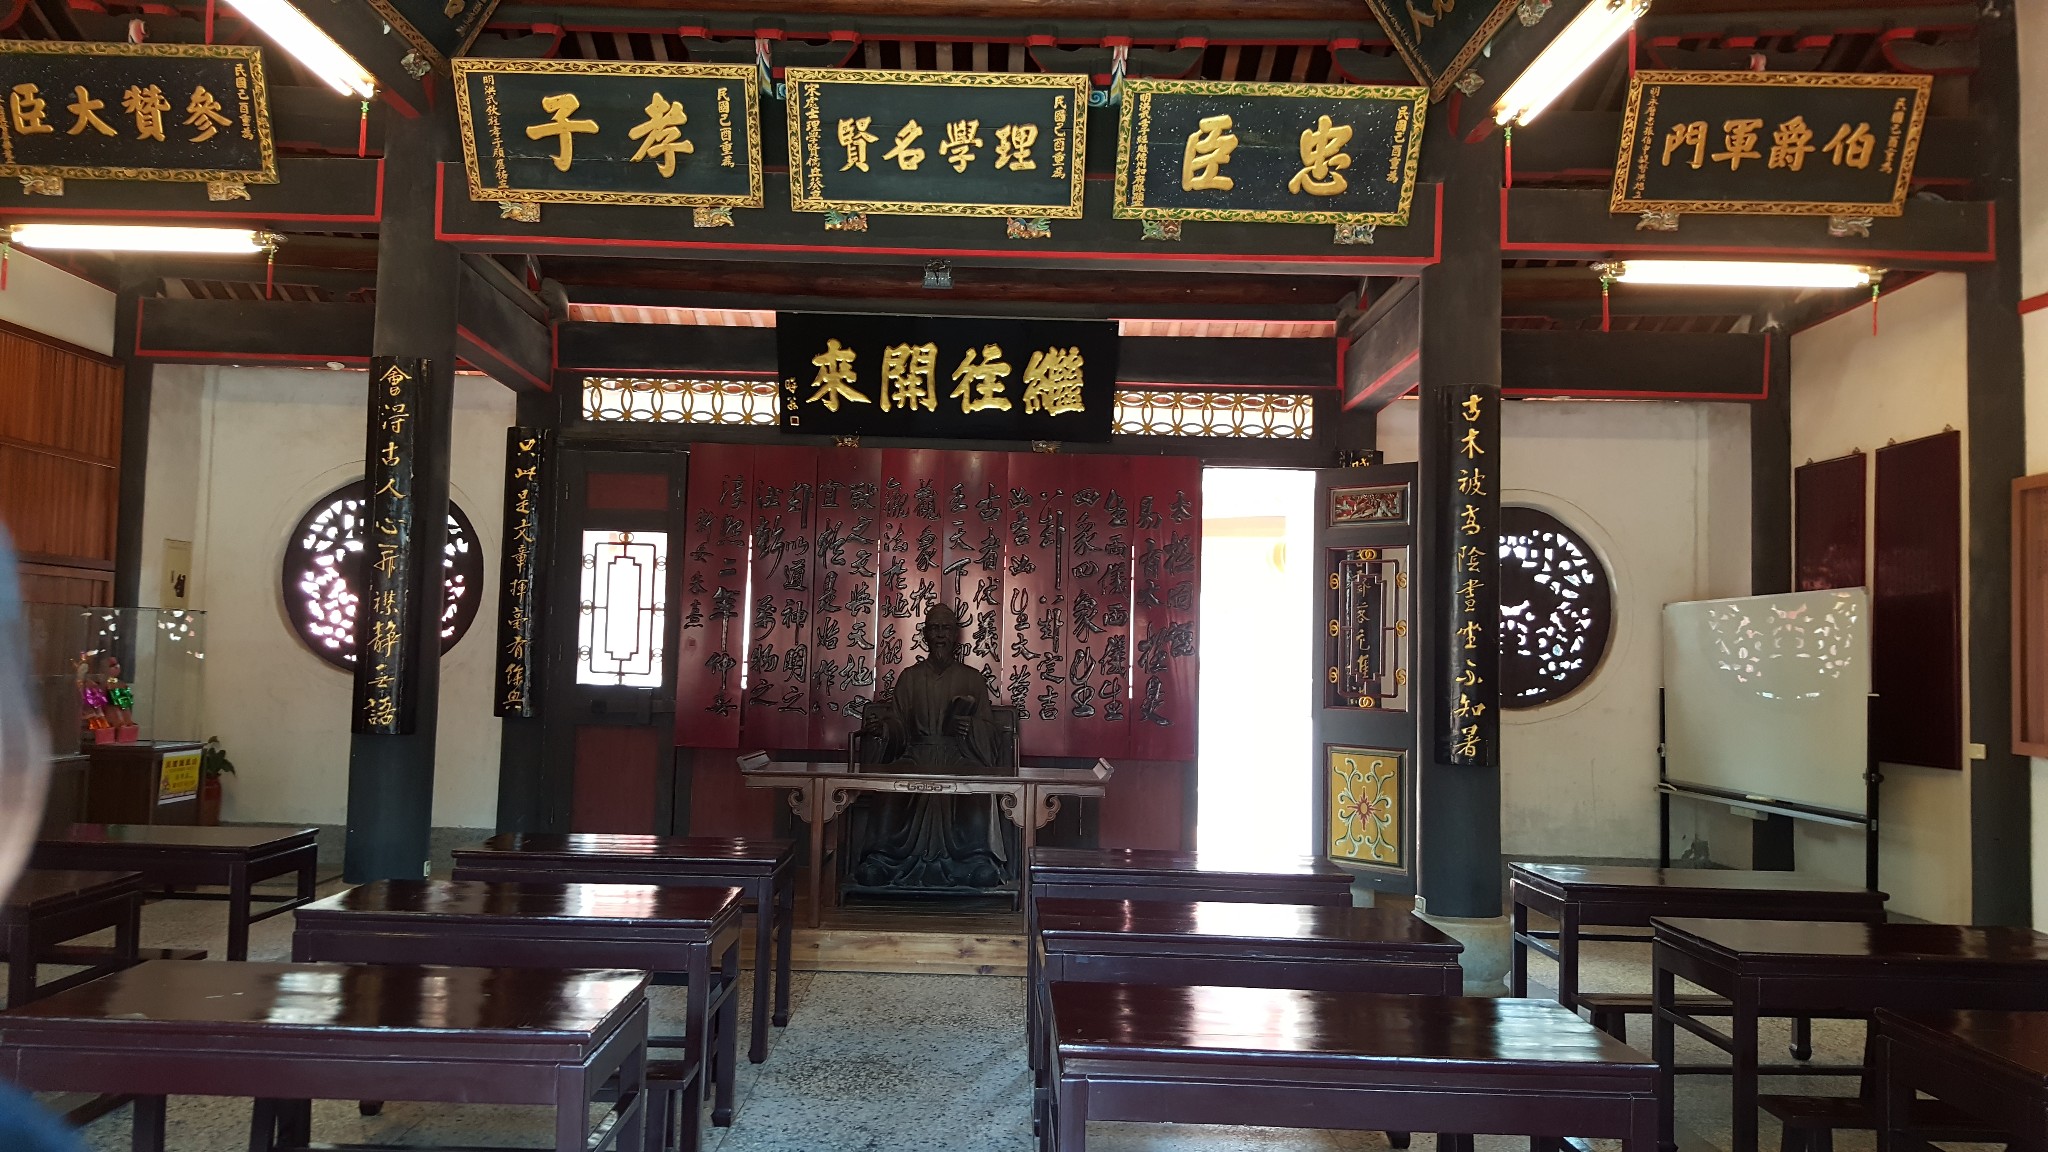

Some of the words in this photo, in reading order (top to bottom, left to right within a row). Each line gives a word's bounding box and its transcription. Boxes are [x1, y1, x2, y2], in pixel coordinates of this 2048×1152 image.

[10, 82, 233, 143] 參贊大臣
[525, 92, 694, 178] 孝子
[836, 116, 1039, 174] 理學名賢
[1661, 115, 1876, 172] 伯爵軍門
[1182, 114, 1353, 196] 忠臣
[805, 338, 1085, 416] 繼往開來
